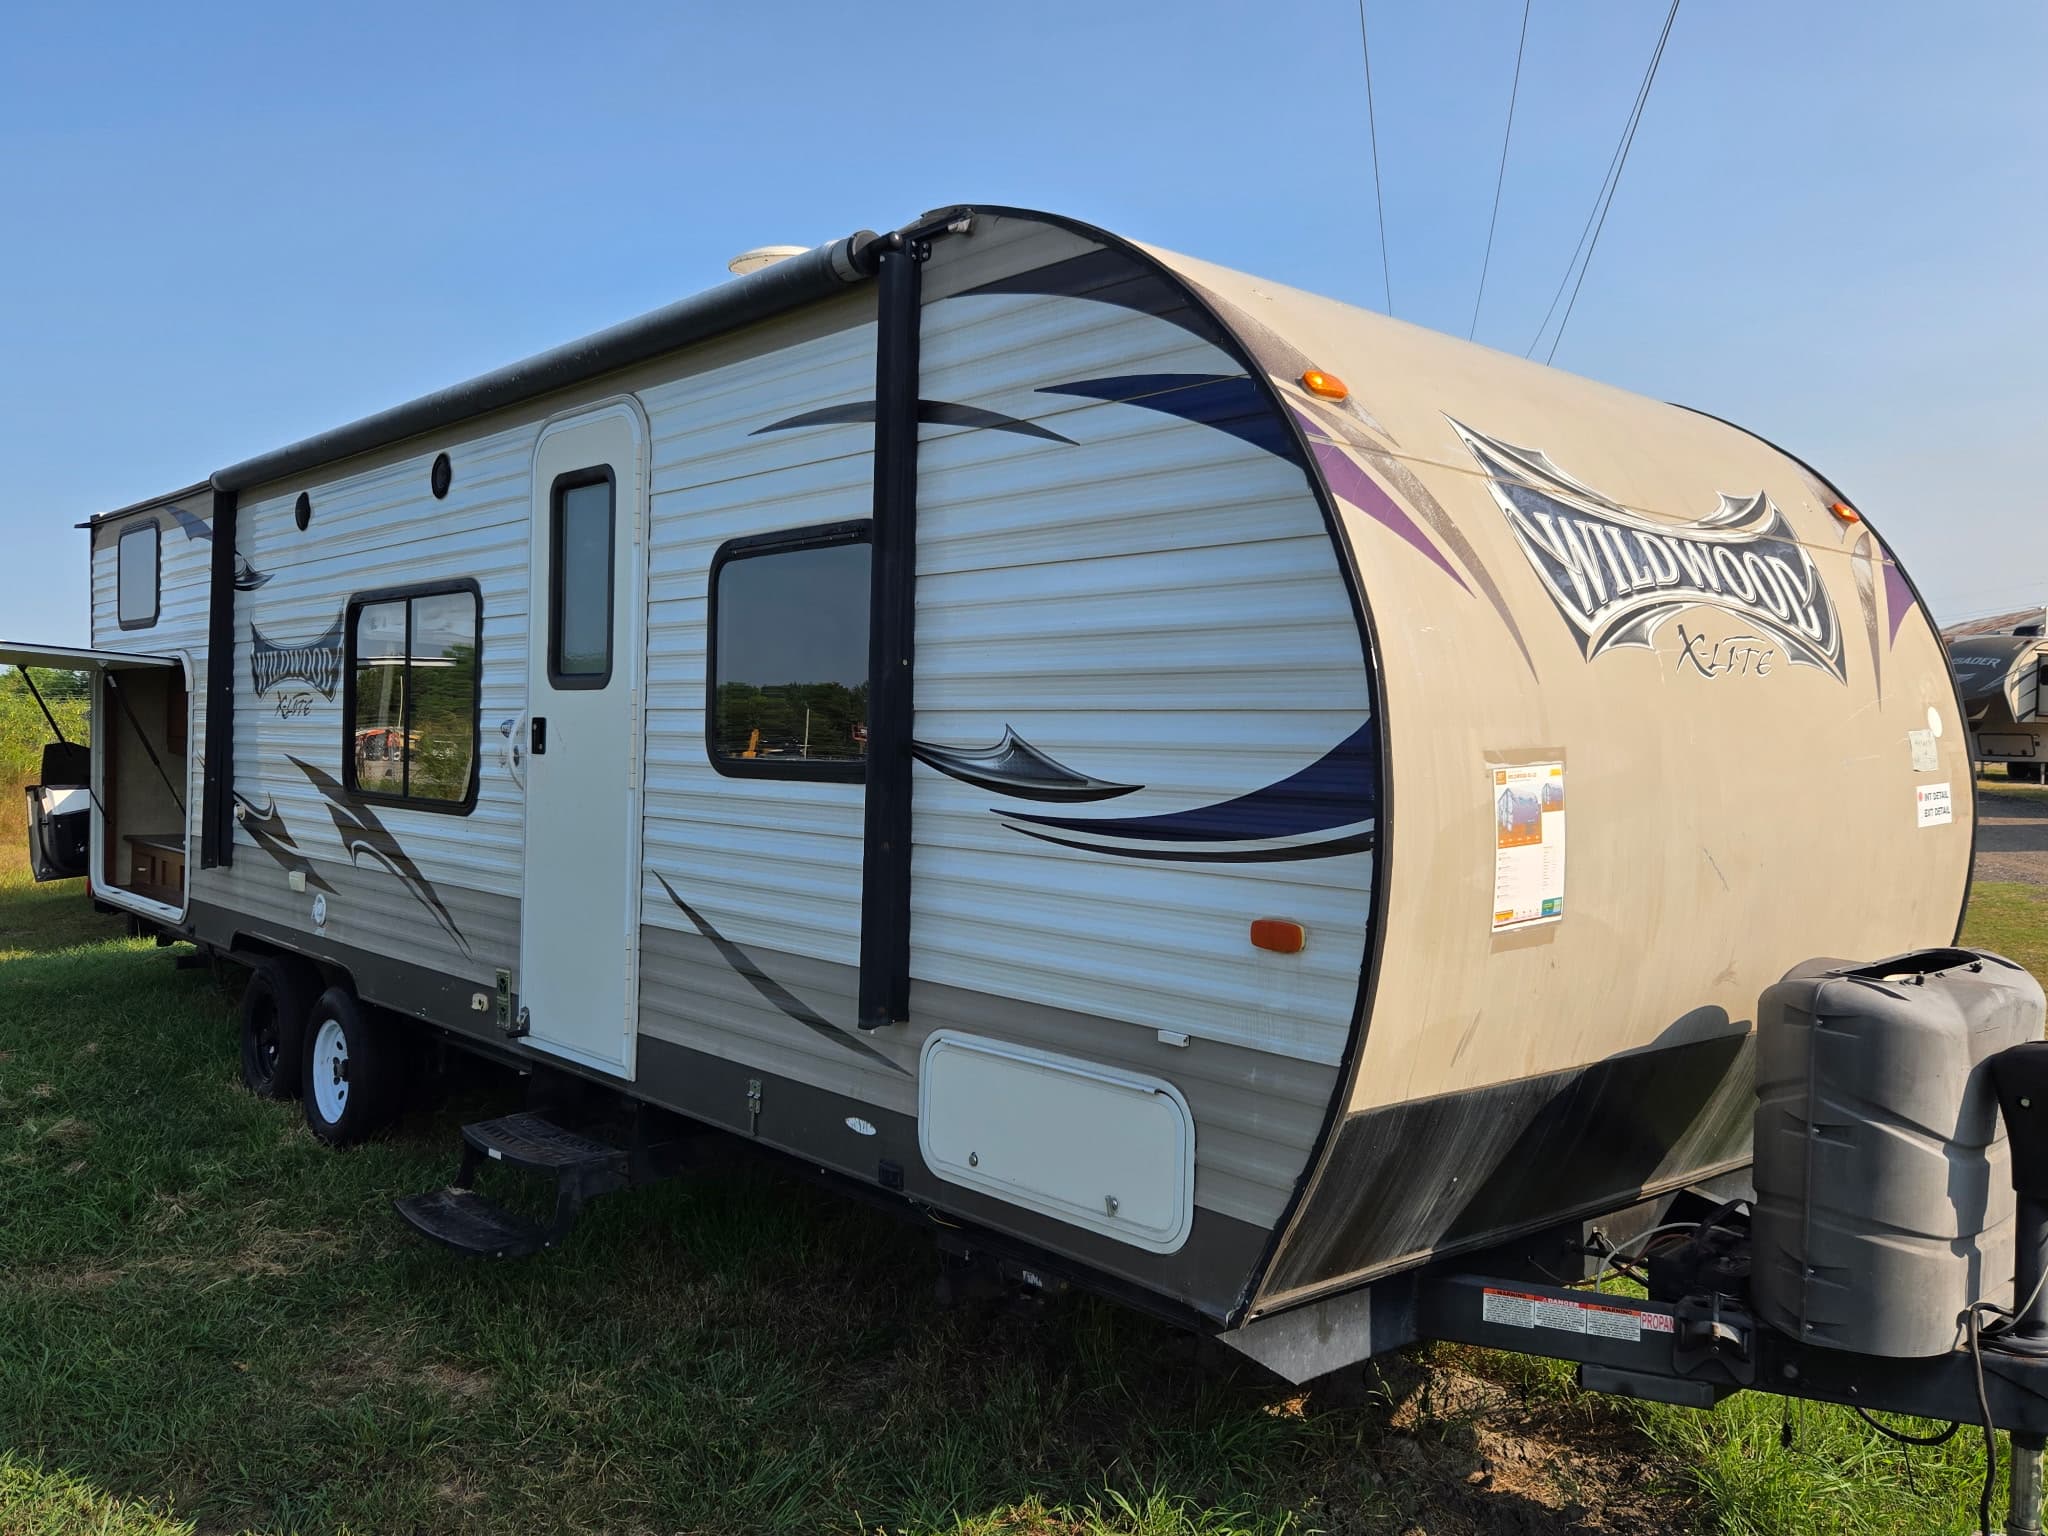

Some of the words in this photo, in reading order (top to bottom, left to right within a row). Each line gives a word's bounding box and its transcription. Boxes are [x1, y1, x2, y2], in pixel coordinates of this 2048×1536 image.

[1532, 511, 1823, 641] WILDWOOD
[1676, 623, 1775, 680] X-LITE
[252, 647, 334, 695] WILDWOOD
[1933, 791, 1949, 800] DETAIL
[1934, 806, 1951, 816] DETAIL
[1601, 1306, 1632, 1315] WARNING
